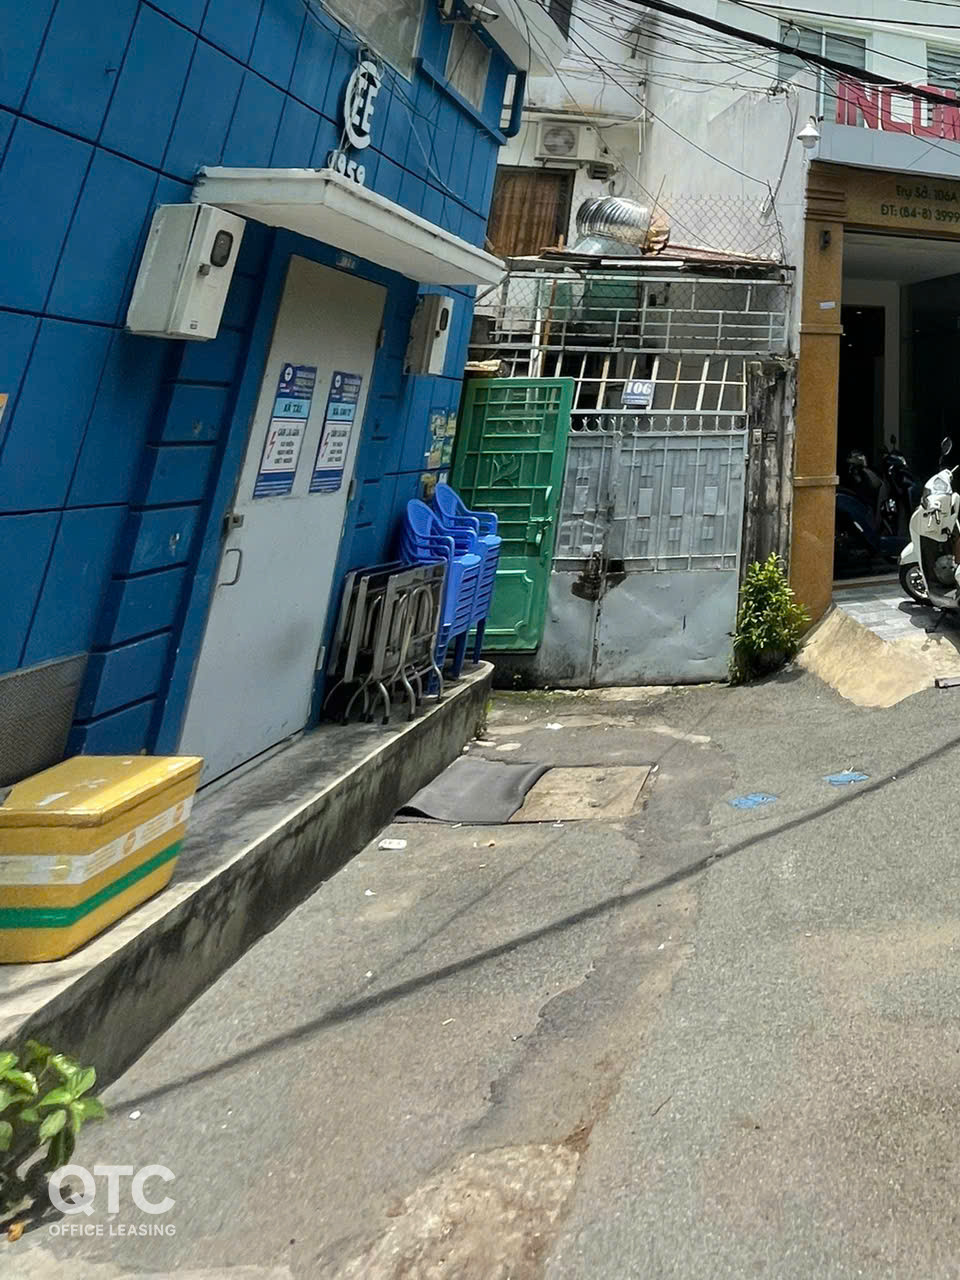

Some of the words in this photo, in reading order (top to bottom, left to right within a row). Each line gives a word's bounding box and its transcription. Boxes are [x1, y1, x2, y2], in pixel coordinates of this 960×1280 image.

[933, 190, 957, 202] 106A
[881, 203, 898, 217] ĐT:
[900, 206, 932, 221] (84-8)
[626, 381, 652, 395] 106
